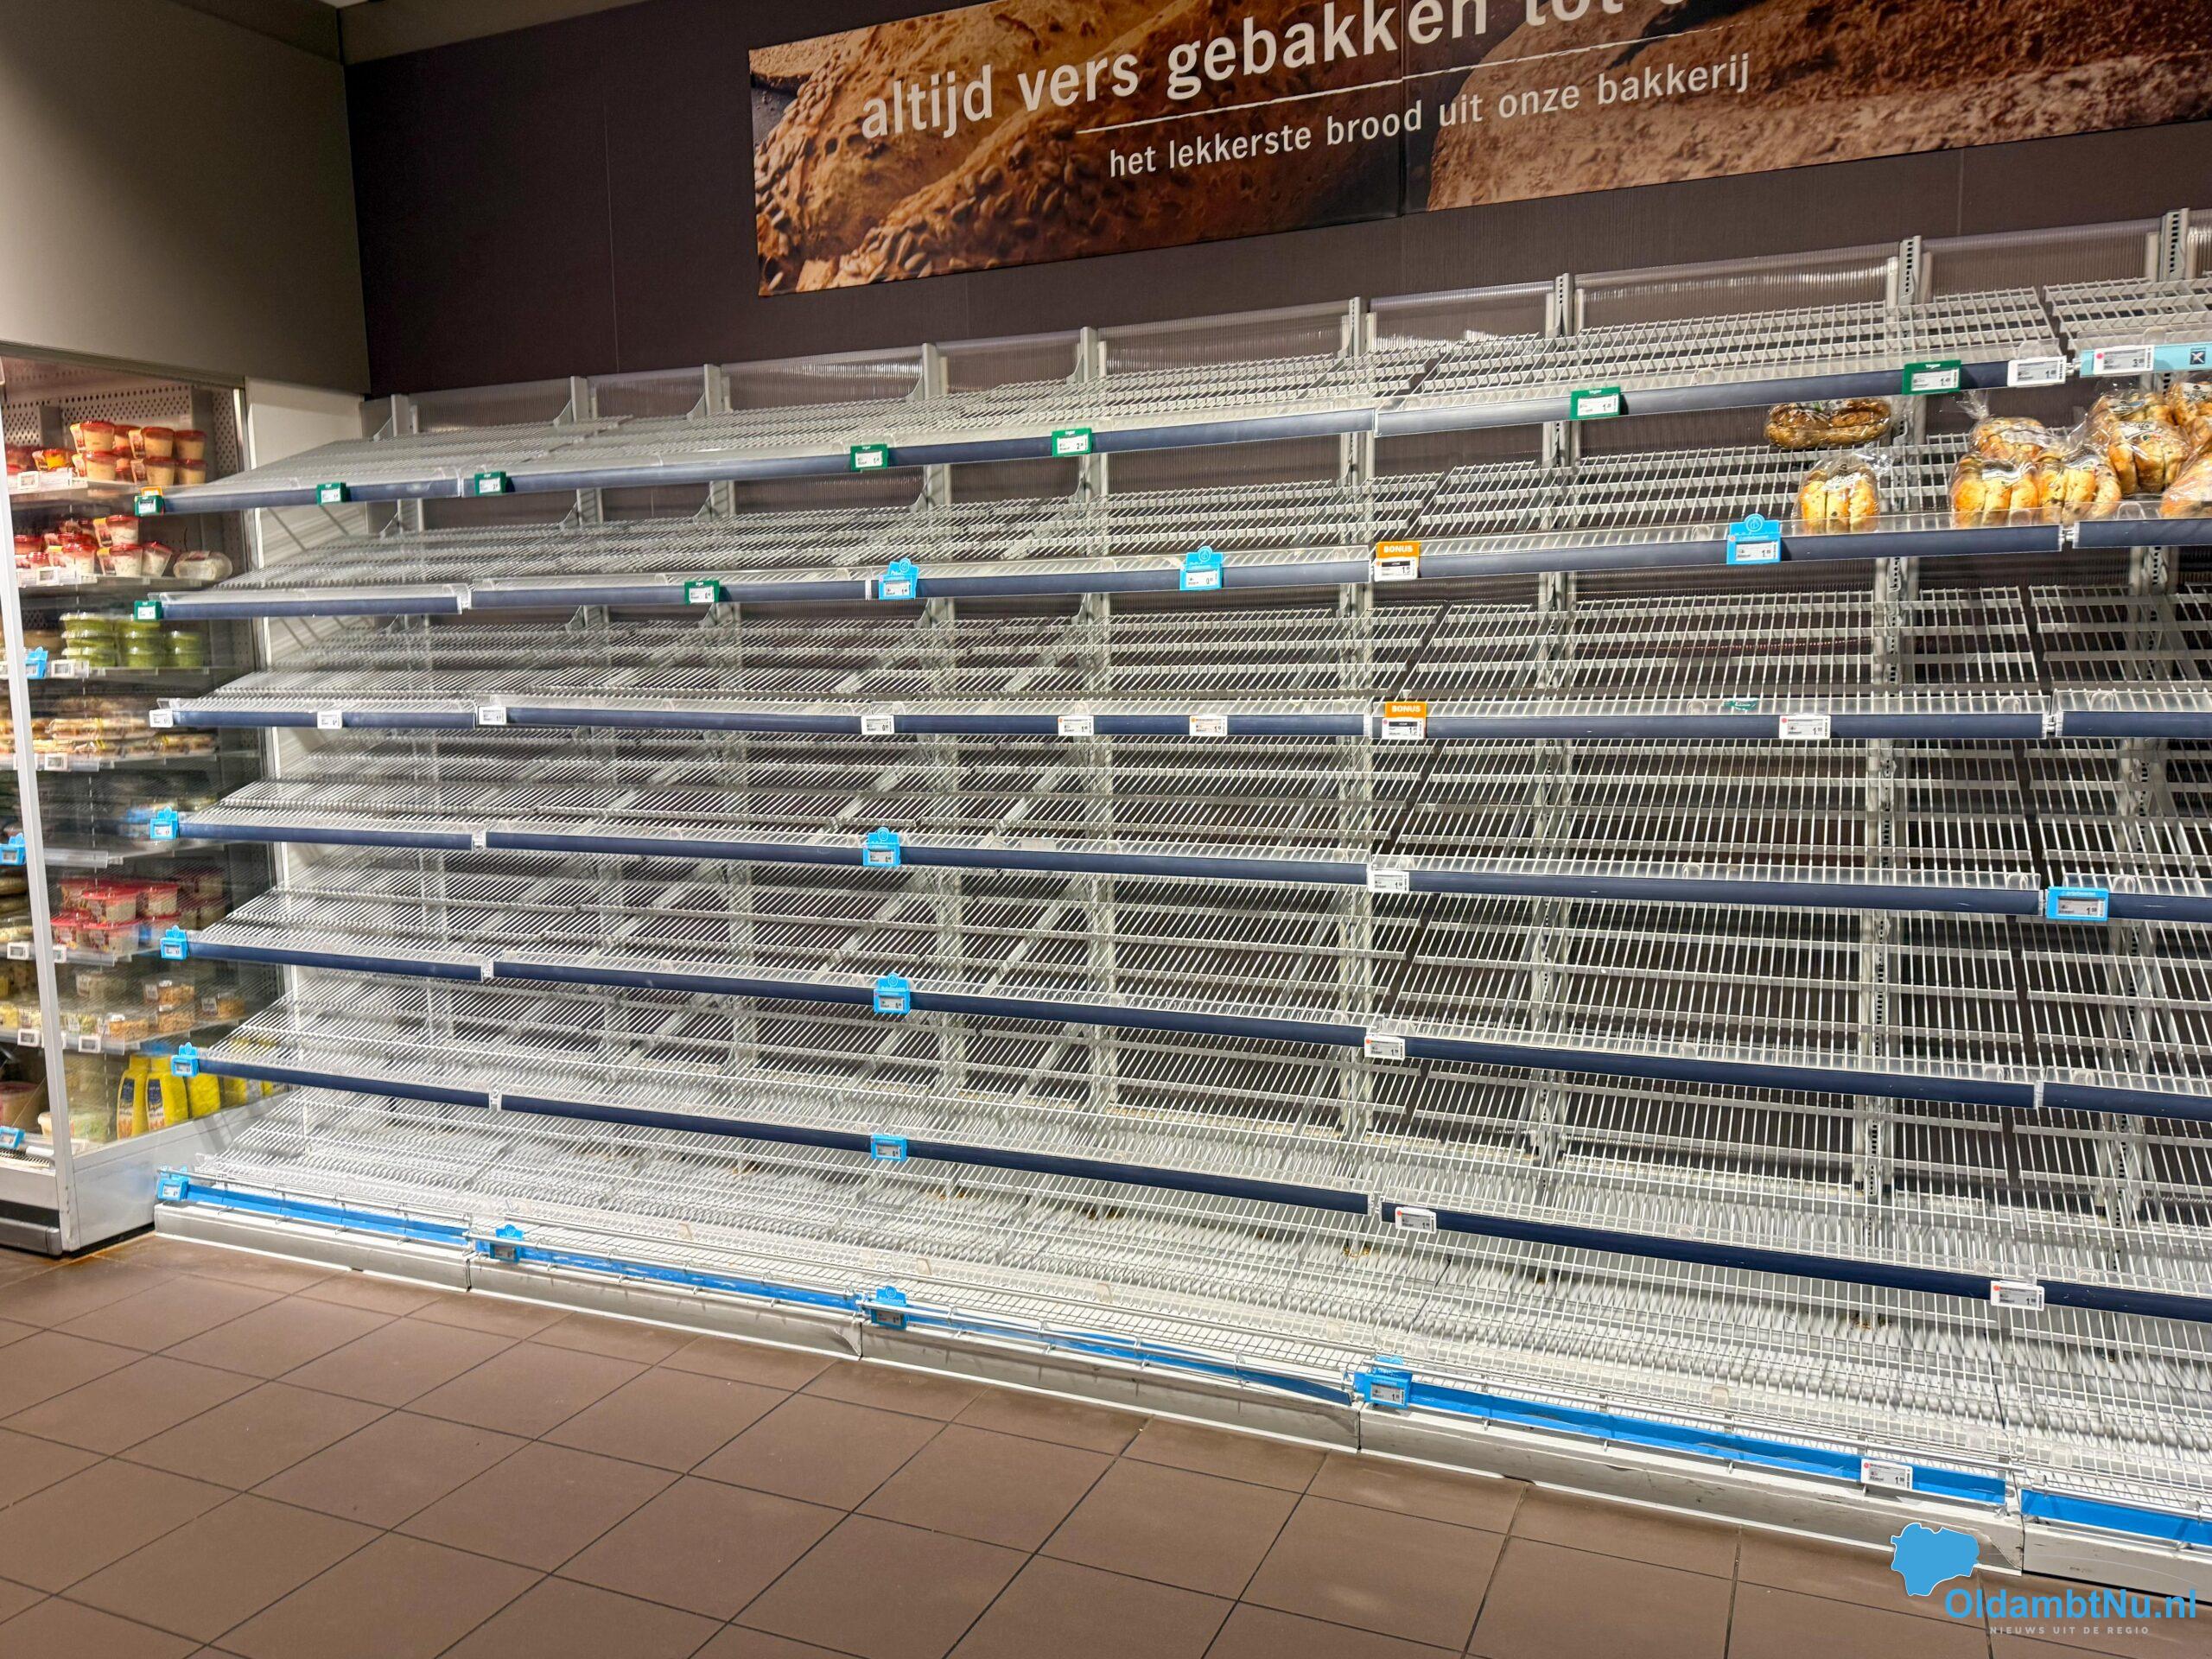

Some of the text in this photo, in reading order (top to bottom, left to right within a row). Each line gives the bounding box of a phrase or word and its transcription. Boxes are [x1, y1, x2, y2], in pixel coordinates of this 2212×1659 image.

[861, 64, 993, 138] altijd
[1017, 53, 1139, 111] vers
[1166, 0, 1485, 100] gebakken
[1109, 53, 1749, 177] het lekkerste brood uit onze bakkerij
